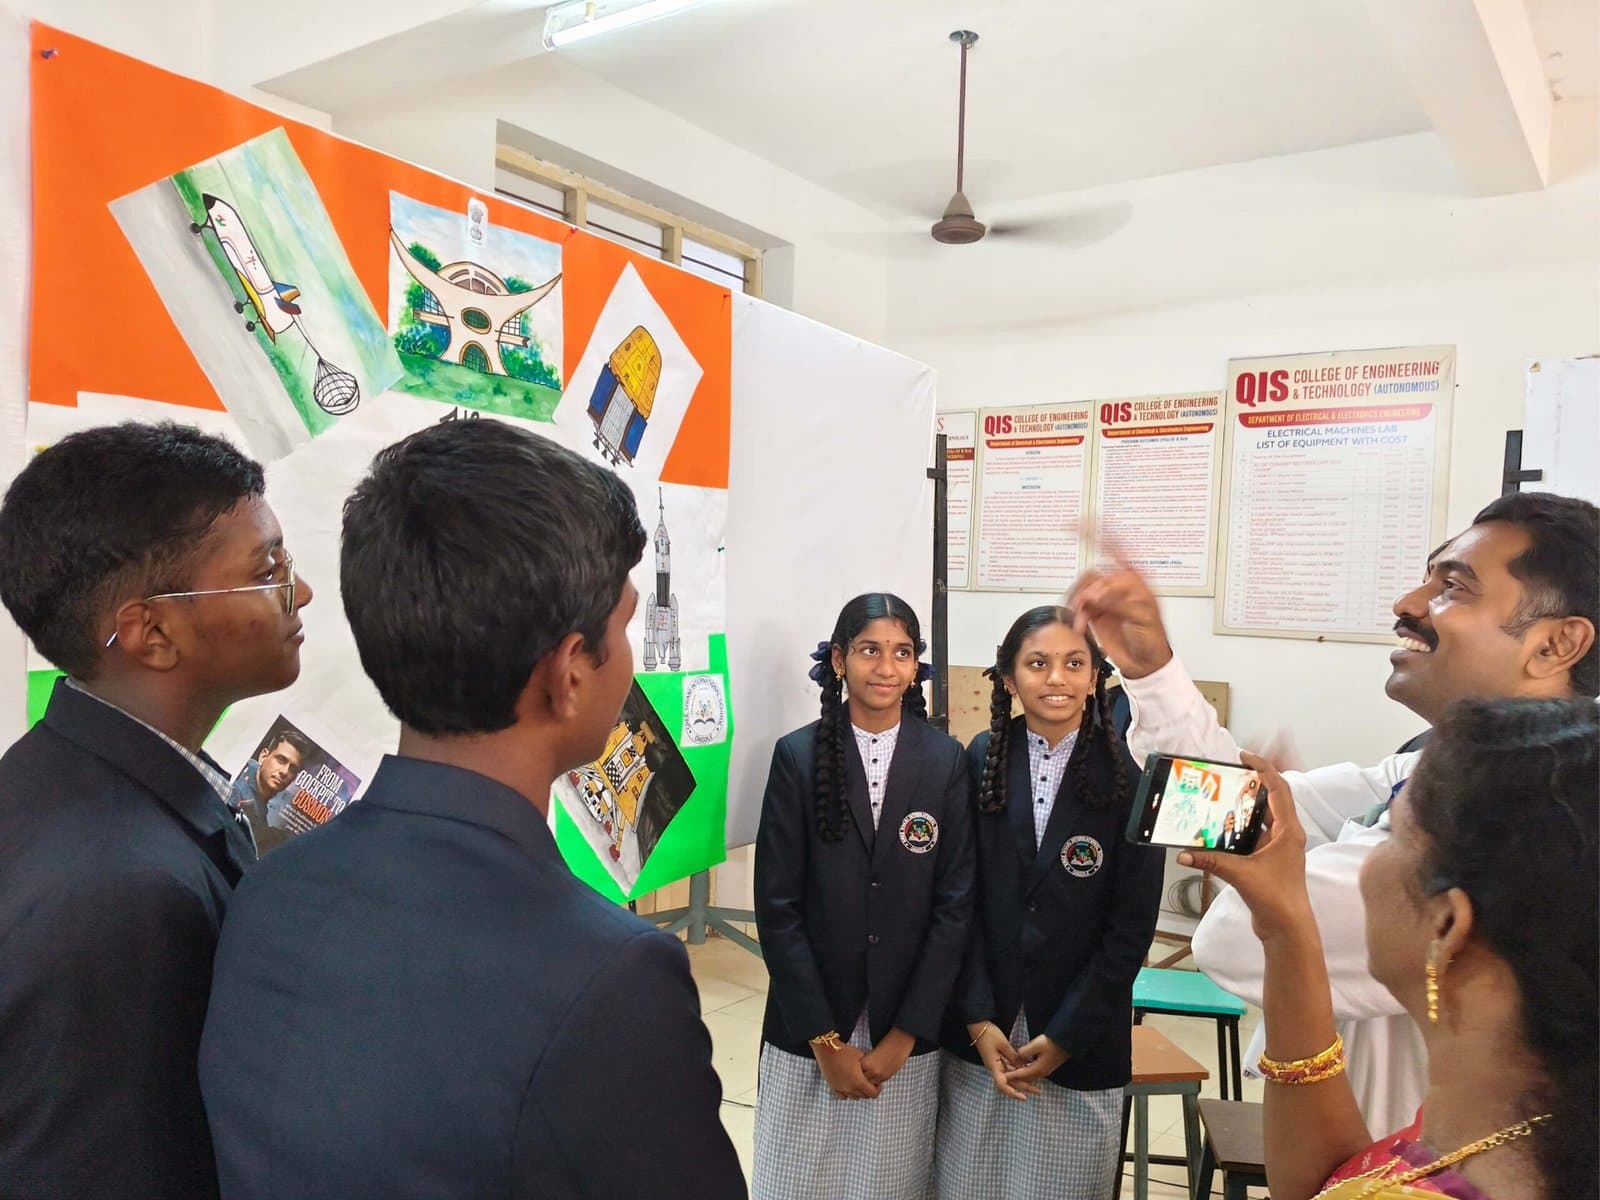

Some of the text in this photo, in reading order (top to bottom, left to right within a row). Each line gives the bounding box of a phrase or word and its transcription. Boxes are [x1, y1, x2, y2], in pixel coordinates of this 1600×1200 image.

[1294, 361, 1440, 383] COLLEGE OF ENGINEERING
[1236, 370, 1289, 407] QIS
[1293, 380, 1439, 399] & TECHNOLOGY (AUTONOMOUS)
[1134, 396, 1218, 411] COLLEGE OF ENGINEERING
[1014, 411, 1089, 423] COLLEGE OF ENGINEERING
[1100, 402, 1132, 425] QIS
[1140, 410, 1179, 421] TECHNOLOGY
[1248, 415, 1285, 425] DEPARTMENT
[1287, 414, 1294, 423] OF
[1295, 412, 1330, 422] ELECTRICAL
[985, 415, 1012, 436] QIS
[1019, 423, 1054, 433] TECHNOLOGY
[1267, 424, 1398, 438] ELECTRICAL MACHINES LAB
[1256, 435, 1408, 449] LIST OF EQUIPMENT WITH COST
[316, 764, 344, 794] FROM
[295, 770, 346, 815] COCKPIT TO
